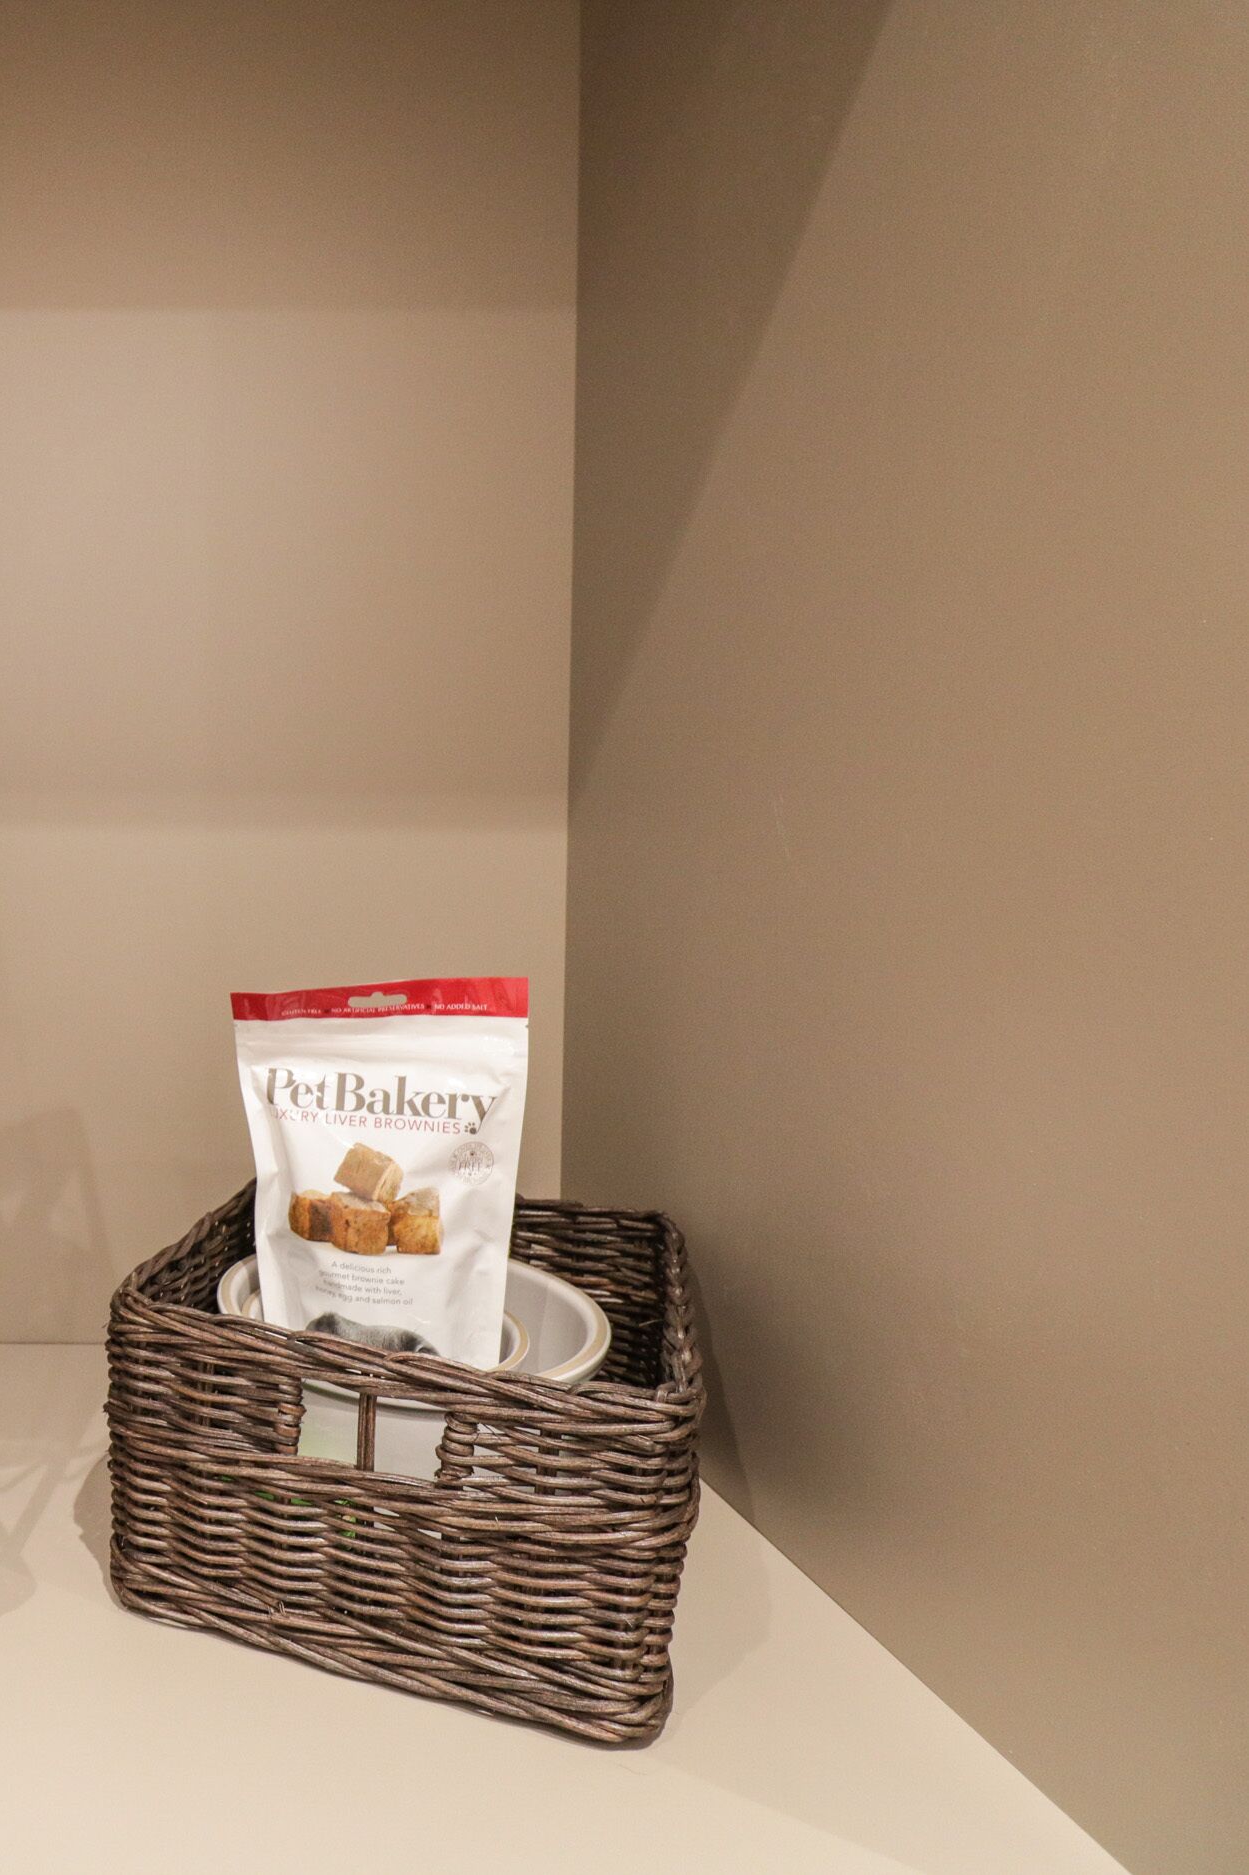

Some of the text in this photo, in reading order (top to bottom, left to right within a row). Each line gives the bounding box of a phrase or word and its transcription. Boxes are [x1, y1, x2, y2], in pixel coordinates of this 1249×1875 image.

[378, 1002, 425, 1013] PRESERVATIVES
[471, 1003, 488, 1011] SALT
[266, 1067, 499, 1133] PetBakery
[325, 1112, 367, 1128] LIVER
[373, 1117, 461, 1135] BROWNIES
[331, 1260, 392, 1275] A delicious rich
[318, 1269, 406, 1286] gourmet brownie cake
[322, 1279, 363, 1293] handmade
[364, 1286, 383, 1295] with
[338, 1293, 353, 1303] egg
[354, 1295, 371, 1304] and
[372, 1297, 402, 1306] salmon
[402, 1297, 414, 1306] oil
